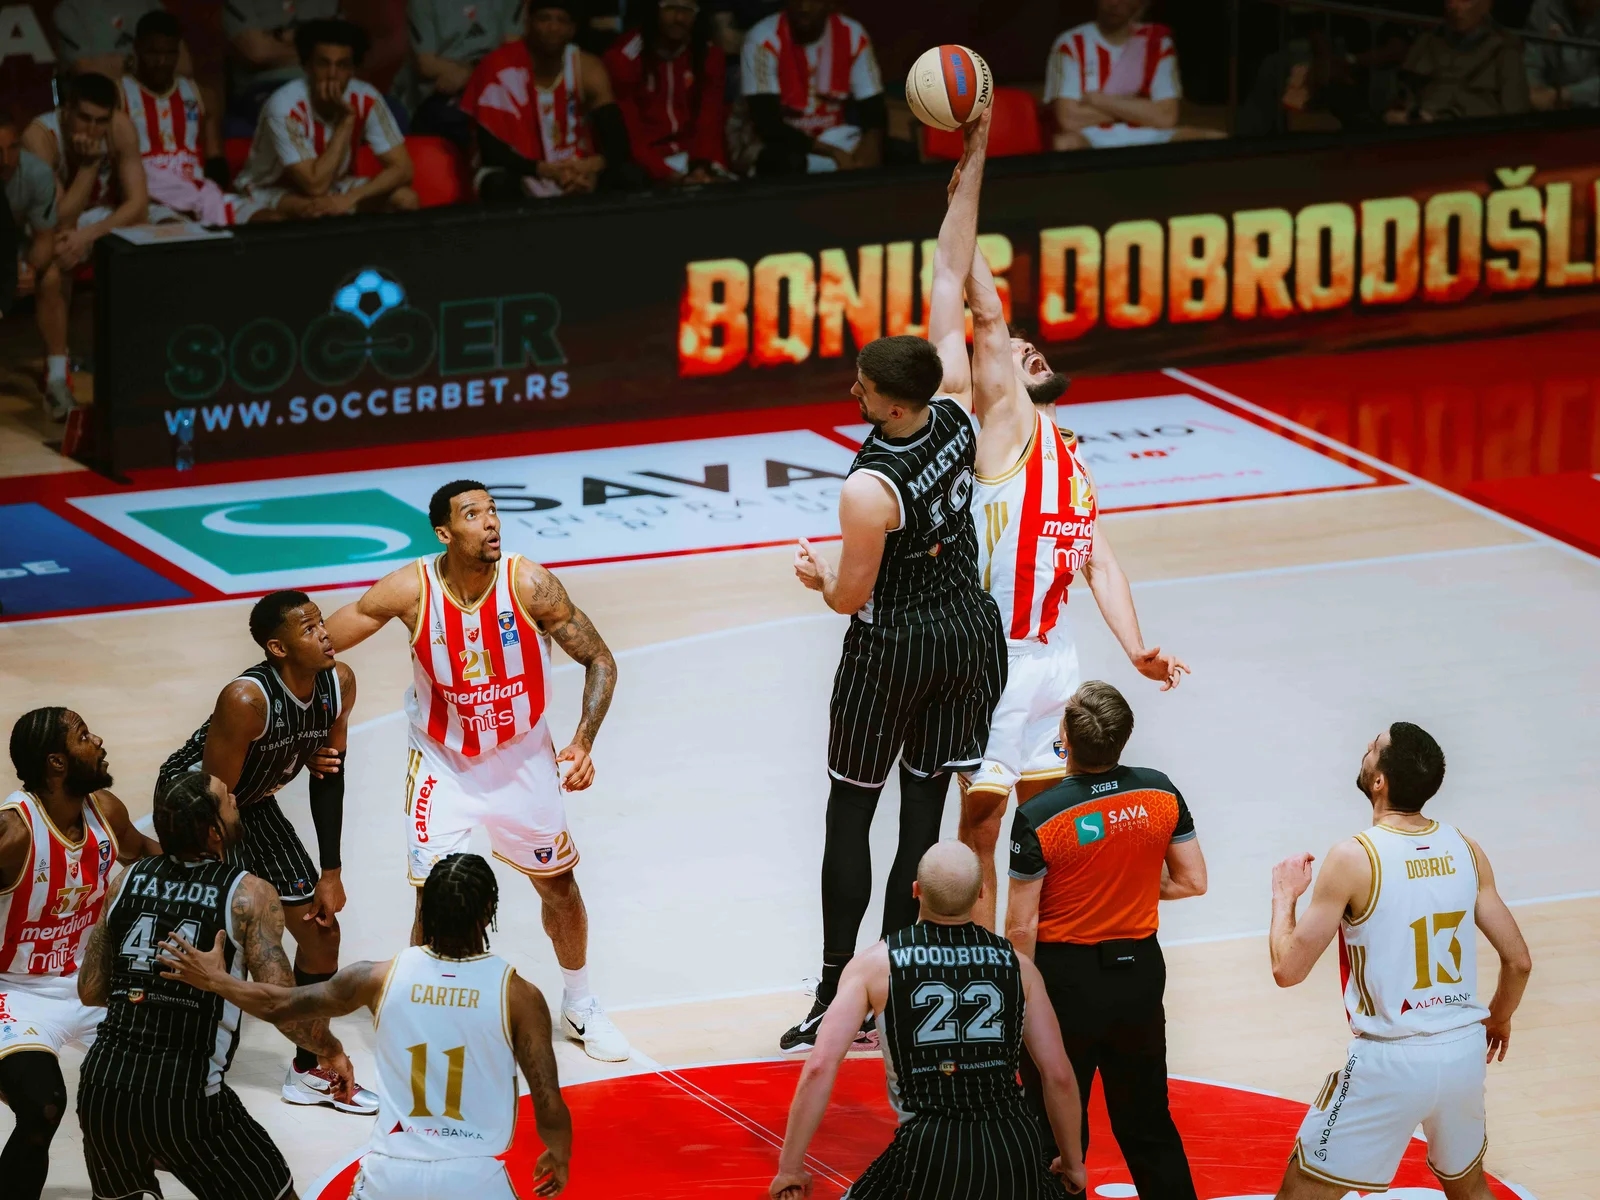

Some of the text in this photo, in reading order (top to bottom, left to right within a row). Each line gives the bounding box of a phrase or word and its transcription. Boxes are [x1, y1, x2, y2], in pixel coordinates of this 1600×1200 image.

[1039, 165, 1600, 342] DOBRODOŠL
[165, 371, 571, 436] WWW.SOCCERBET.RS
[1068, 475, 1093, 511] 12
[1041, 518, 1093, 538] merid
[459, 648, 496, 681] 21
[443, 679, 524, 706] meridian
[459, 707, 514, 733] mts
[415, 774, 438, 844] carnex
[1108, 804, 1149, 824] SAVA
[1405, 850, 1457, 880] DOBRIĆ
[51, 885, 92, 915] 37
[130, 872, 220, 909] TAYLOR
[20, 910, 93, 942] meridian
[28, 939, 80, 971] mts
[119, 911, 202, 976] 44
[890, 944, 1014, 969] WOODBURY
[1409, 910, 1467, 991] 13
[410, 983, 480, 1009] CARTER
[911, 981, 1005, 1047] 22
[405, 1043, 466, 1121] 11
[1327, 1081, 1350, 1128] CONCORD
[1343, 1053, 1358, 1080] WEST
